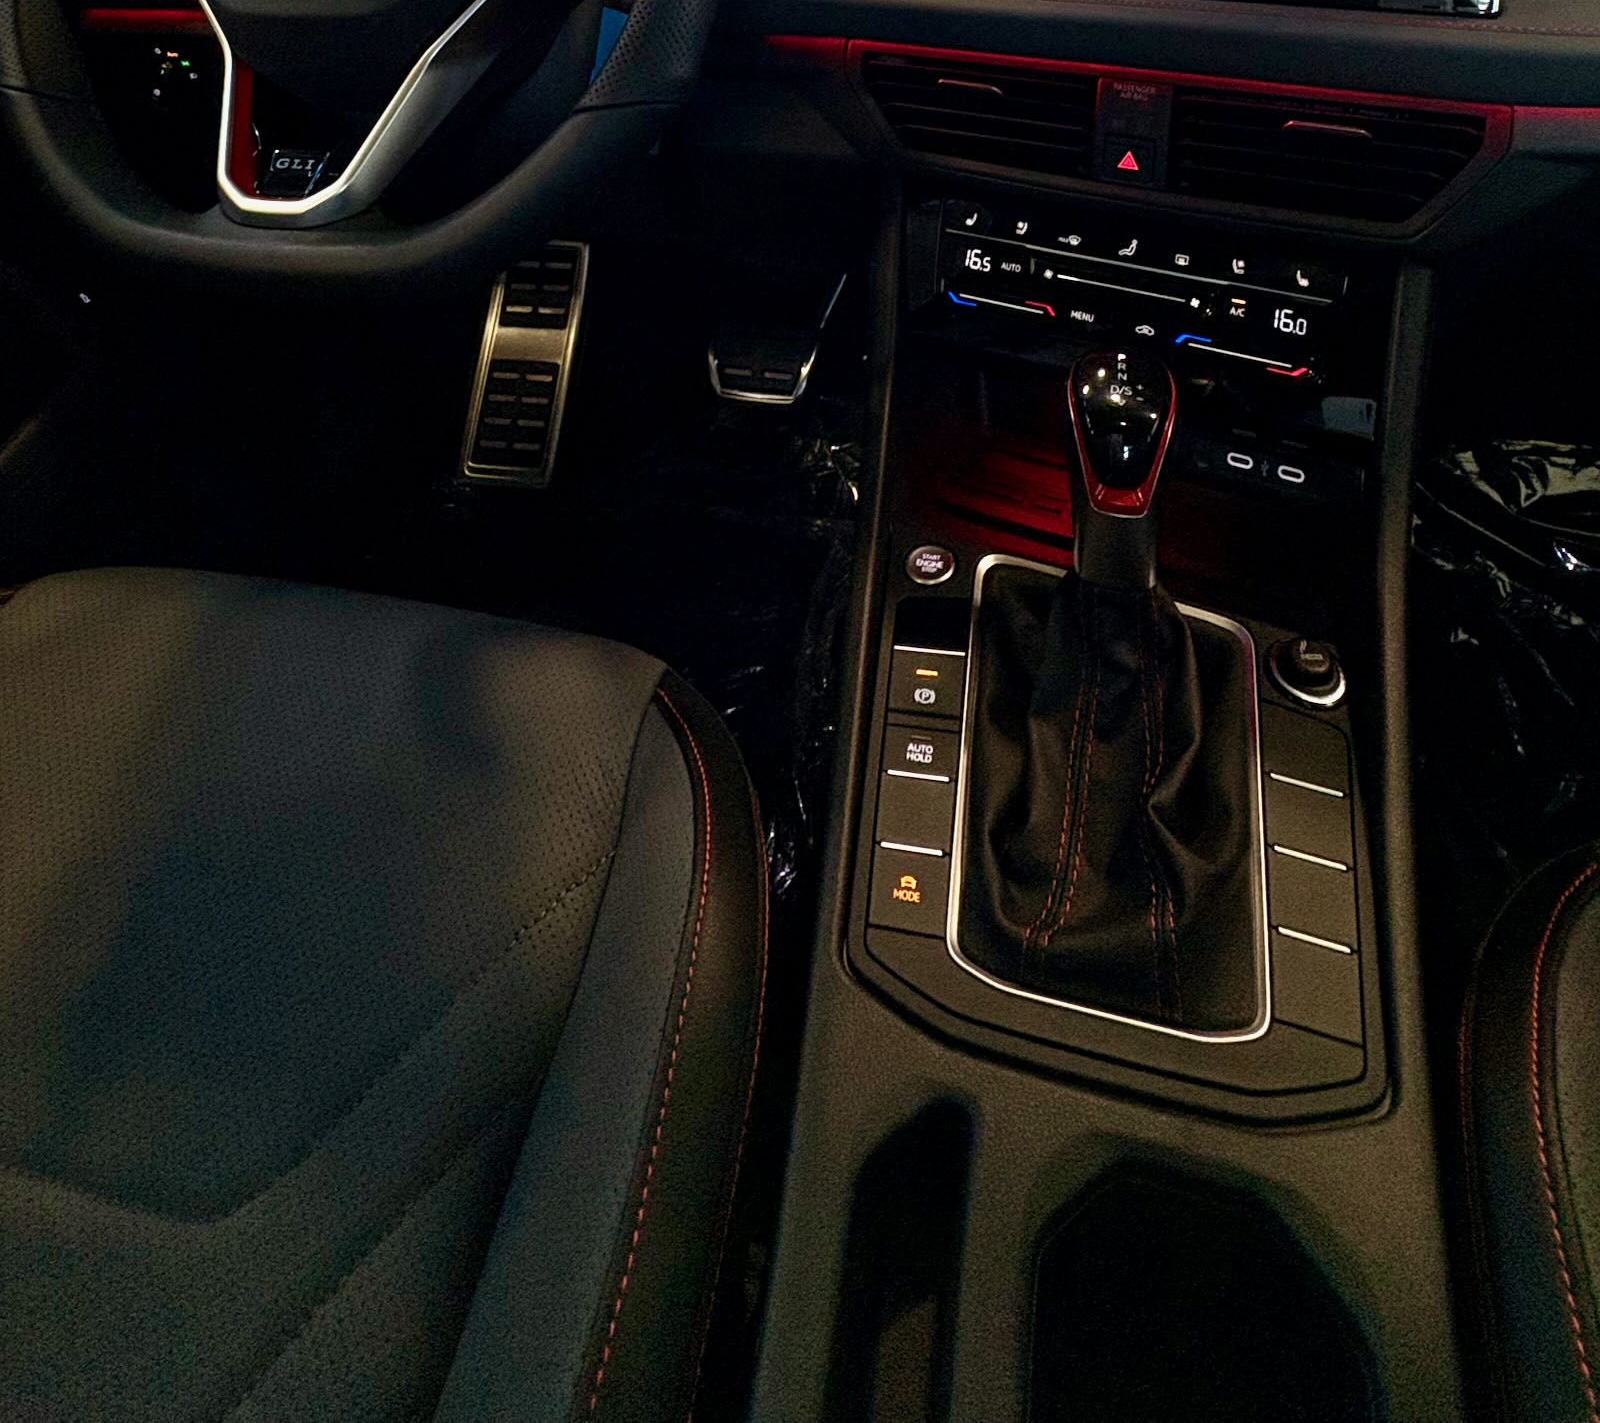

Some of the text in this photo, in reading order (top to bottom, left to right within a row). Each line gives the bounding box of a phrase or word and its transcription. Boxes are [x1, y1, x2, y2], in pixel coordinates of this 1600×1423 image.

[276, 158, 315, 170] GLI
[965, 249, 1022, 273] 16.5 AUTO
[1070, 310, 1095, 323] MENU
[1229, 306, 1246, 317] A/C
[1273, 309, 1307, 335] 16.0
[1117, 353, 1127, 361] P
[1117, 362, 1127, 371] R
[1117, 372, 1128, 381] N
[1110, 384, 1133, 396] D/S
[915, 558, 944, 570] ENGINE
[907, 743, 934, 754] AUTO
[906, 752, 933, 764] HOLD
[893, 888, 921, 903] MODE
